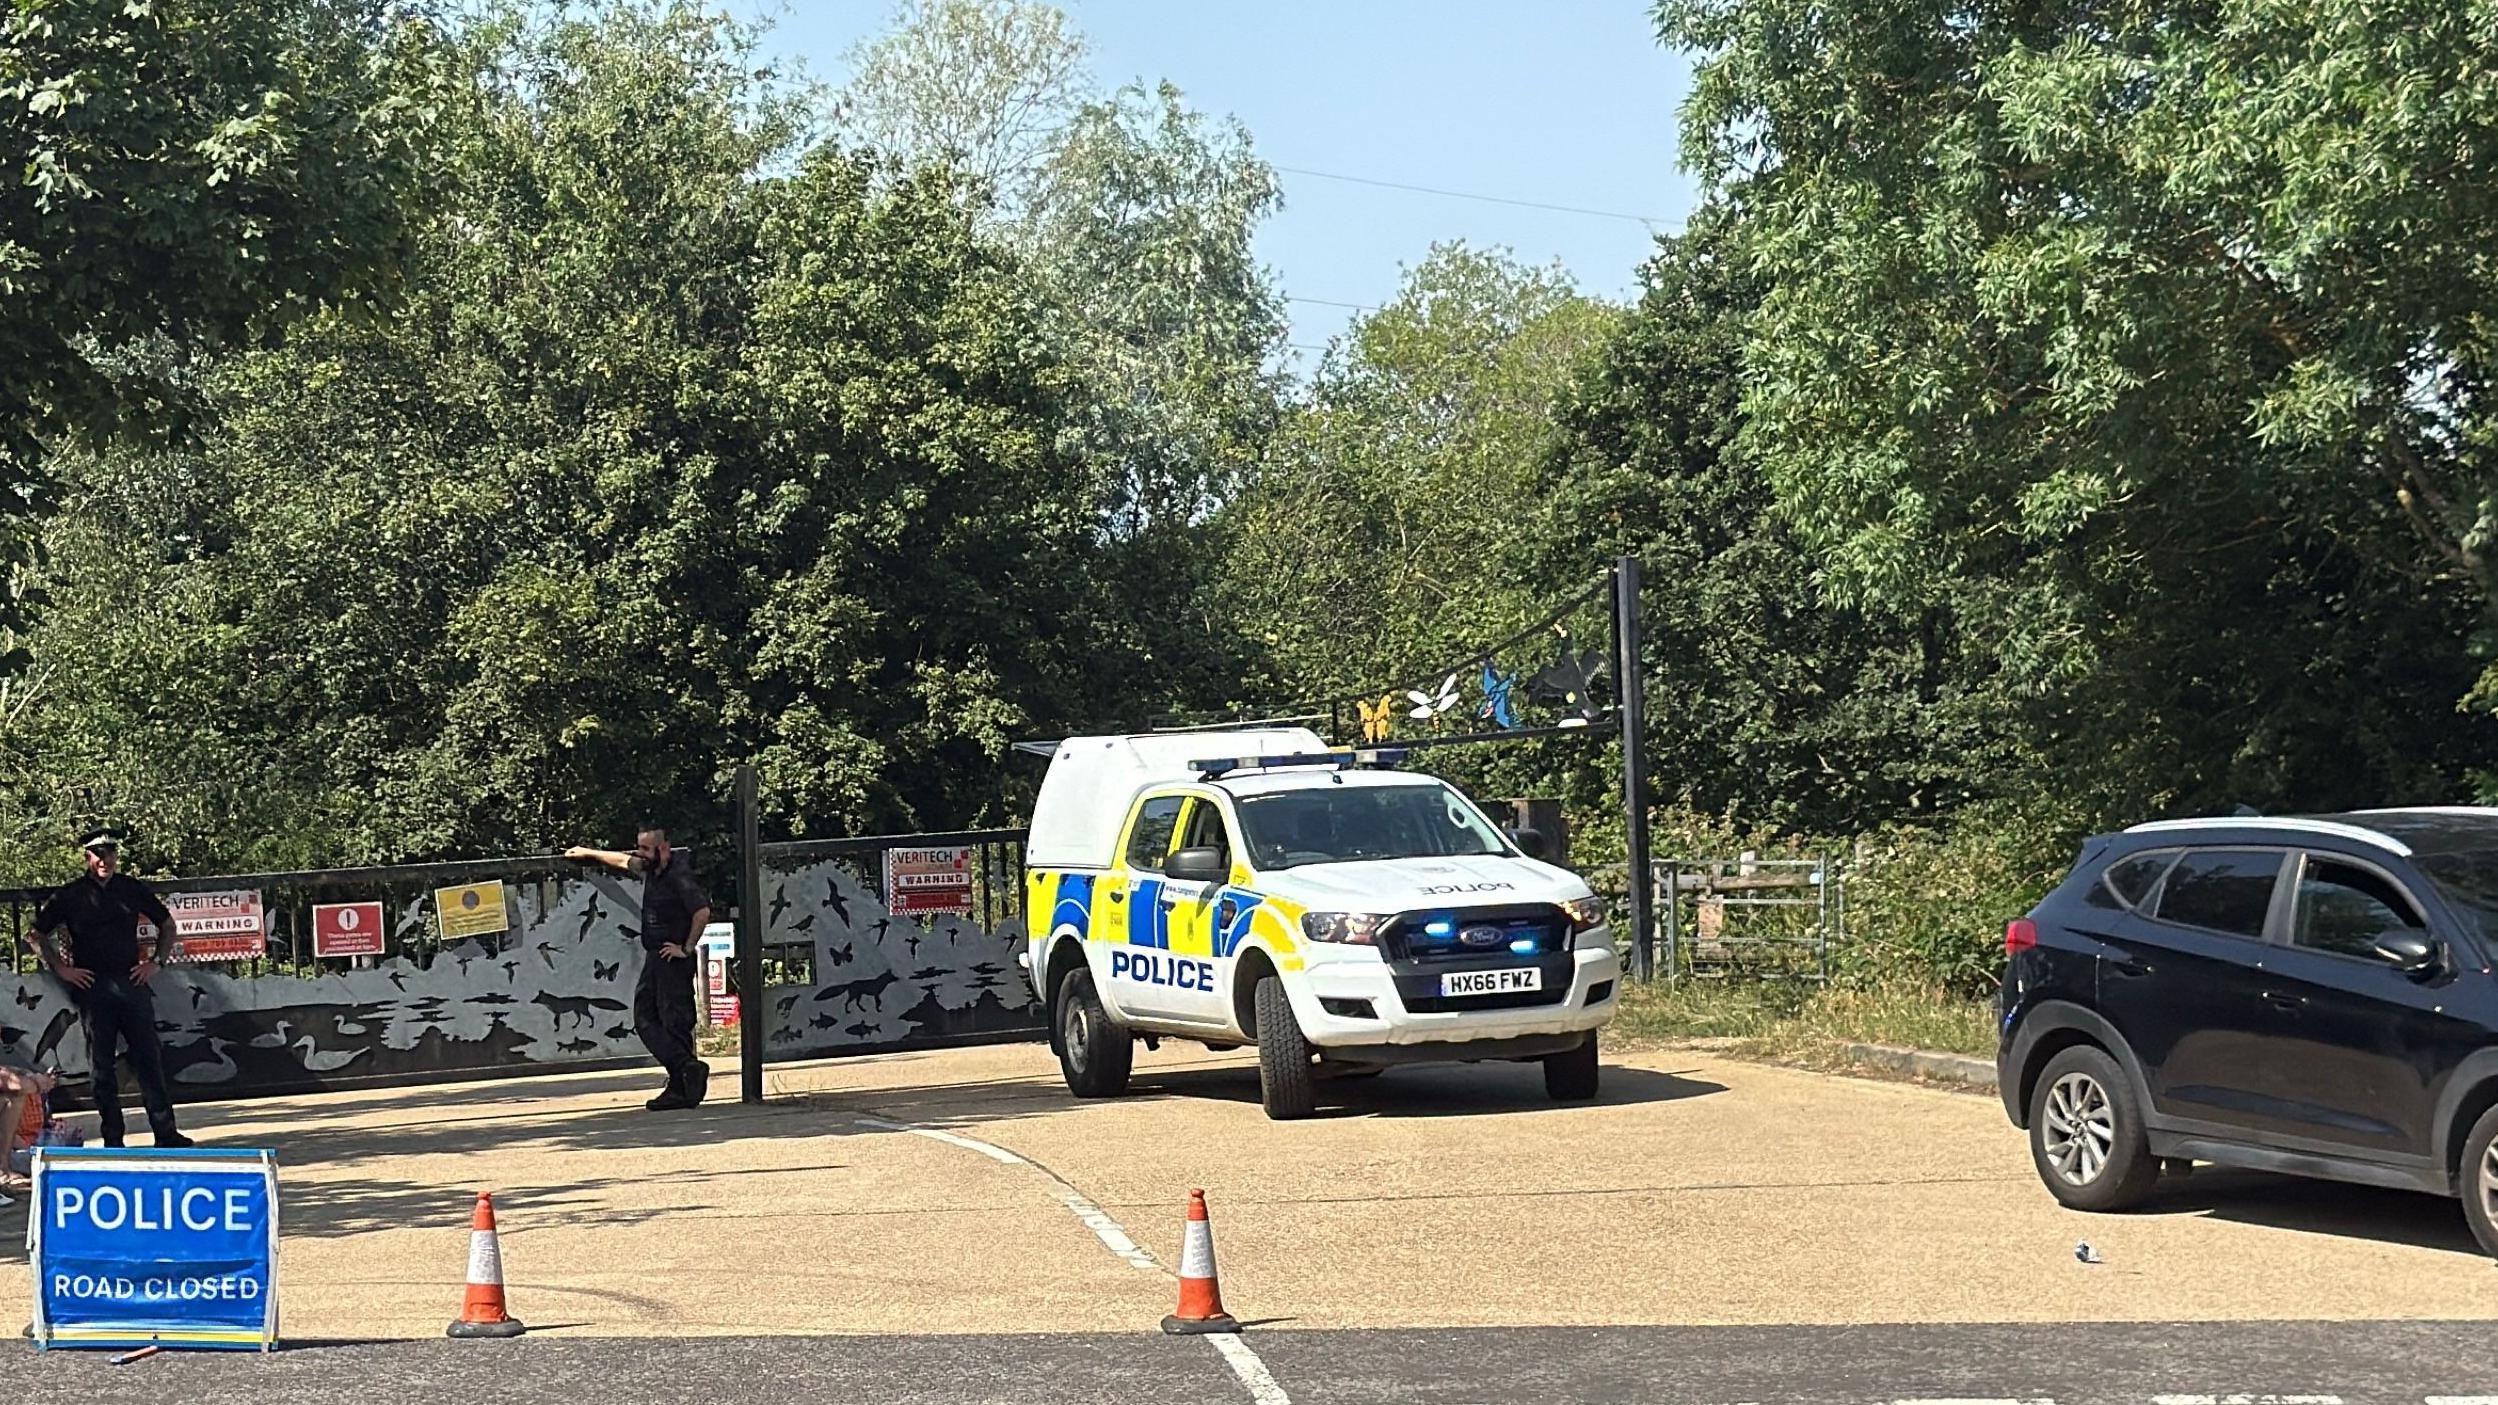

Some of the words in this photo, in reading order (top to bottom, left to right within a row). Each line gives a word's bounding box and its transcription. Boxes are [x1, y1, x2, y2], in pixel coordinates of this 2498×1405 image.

[896, 850, 953, 864] VERITECH
[905, 874, 963, 885] WARNING
[173, 895, 239, 910] VERITECH
[181, 918, 253, 932] WARNING
[1112, 950, 1214, 992] POLICE
[1450, 973, 1496, 993] HX66
[1500, 970, 1534, 990] FWZ
[56, 1185, 252, 1231] POLICE
[54, 1274, 135, 1299] ROAD
[144, 1277, 259, 1301] CLOSED
